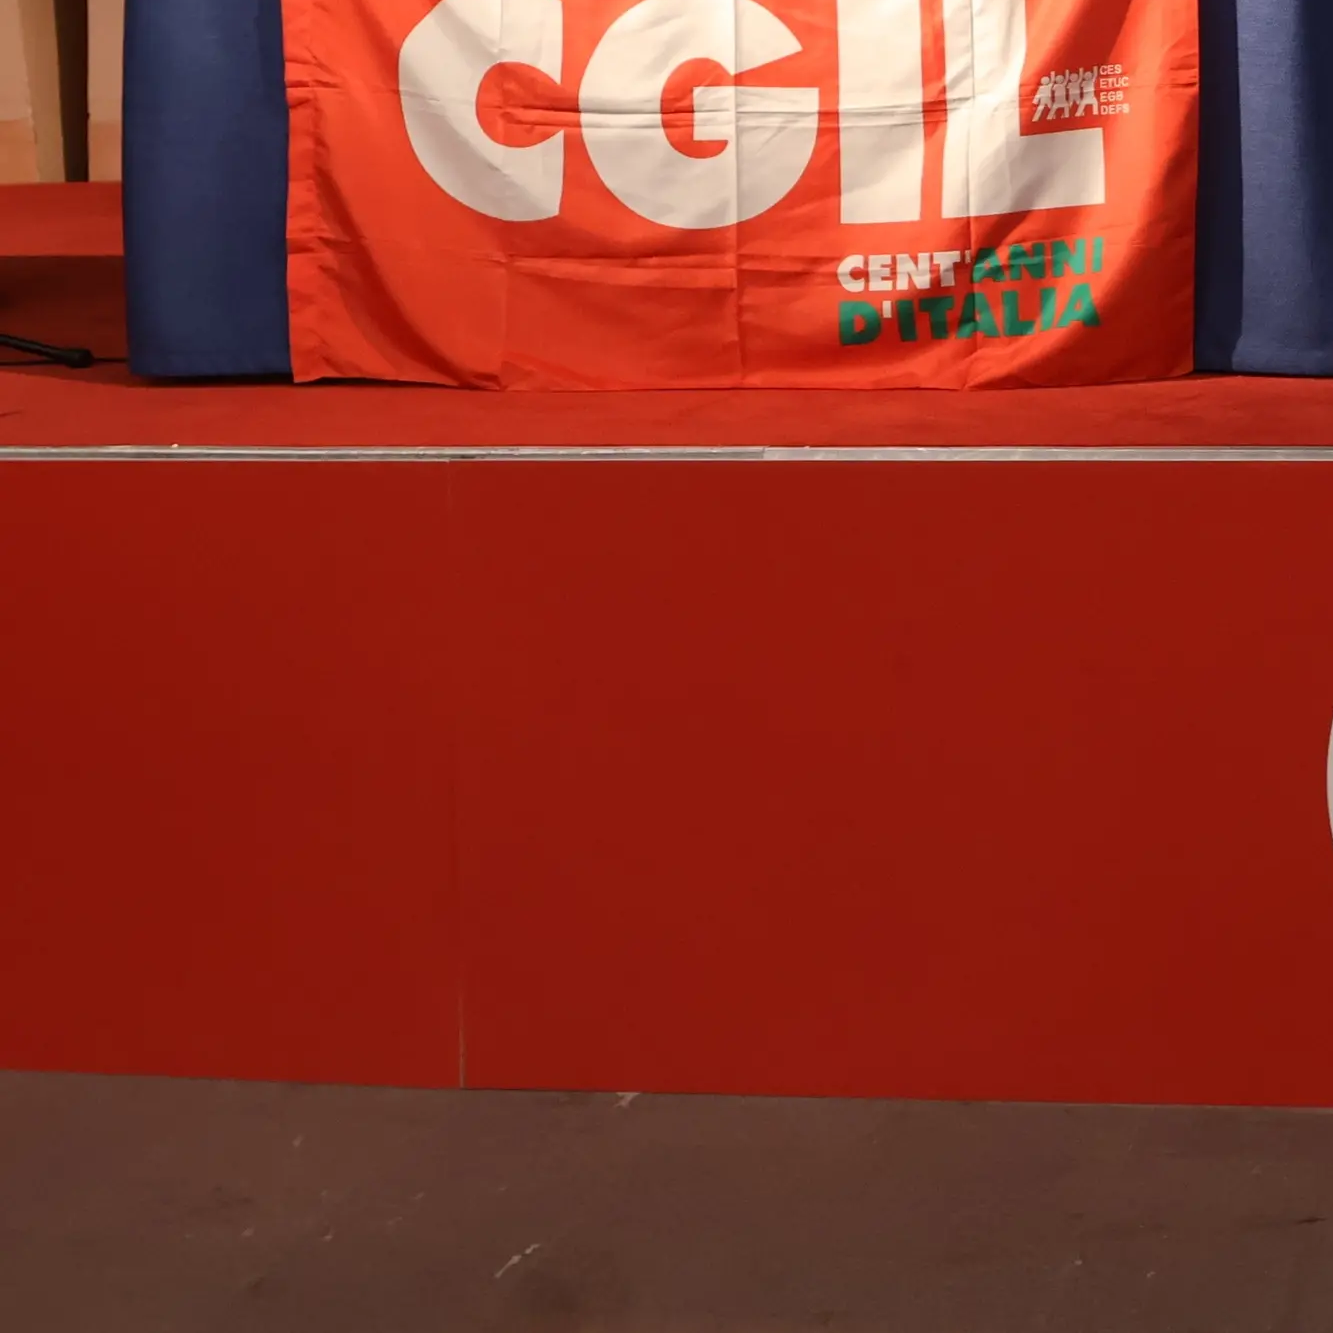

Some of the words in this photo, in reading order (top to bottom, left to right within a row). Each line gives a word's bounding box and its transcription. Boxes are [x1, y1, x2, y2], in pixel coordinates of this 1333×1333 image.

[1100, 64, 1122, 75] CES
[1100, 76, 1129, 88] ETUC
[1101, 103, 1130, 115] DEFS
[837, 237, 1104, 293] CENT'ANNI
[838, 283, 1103, 346] D'ITALIA
